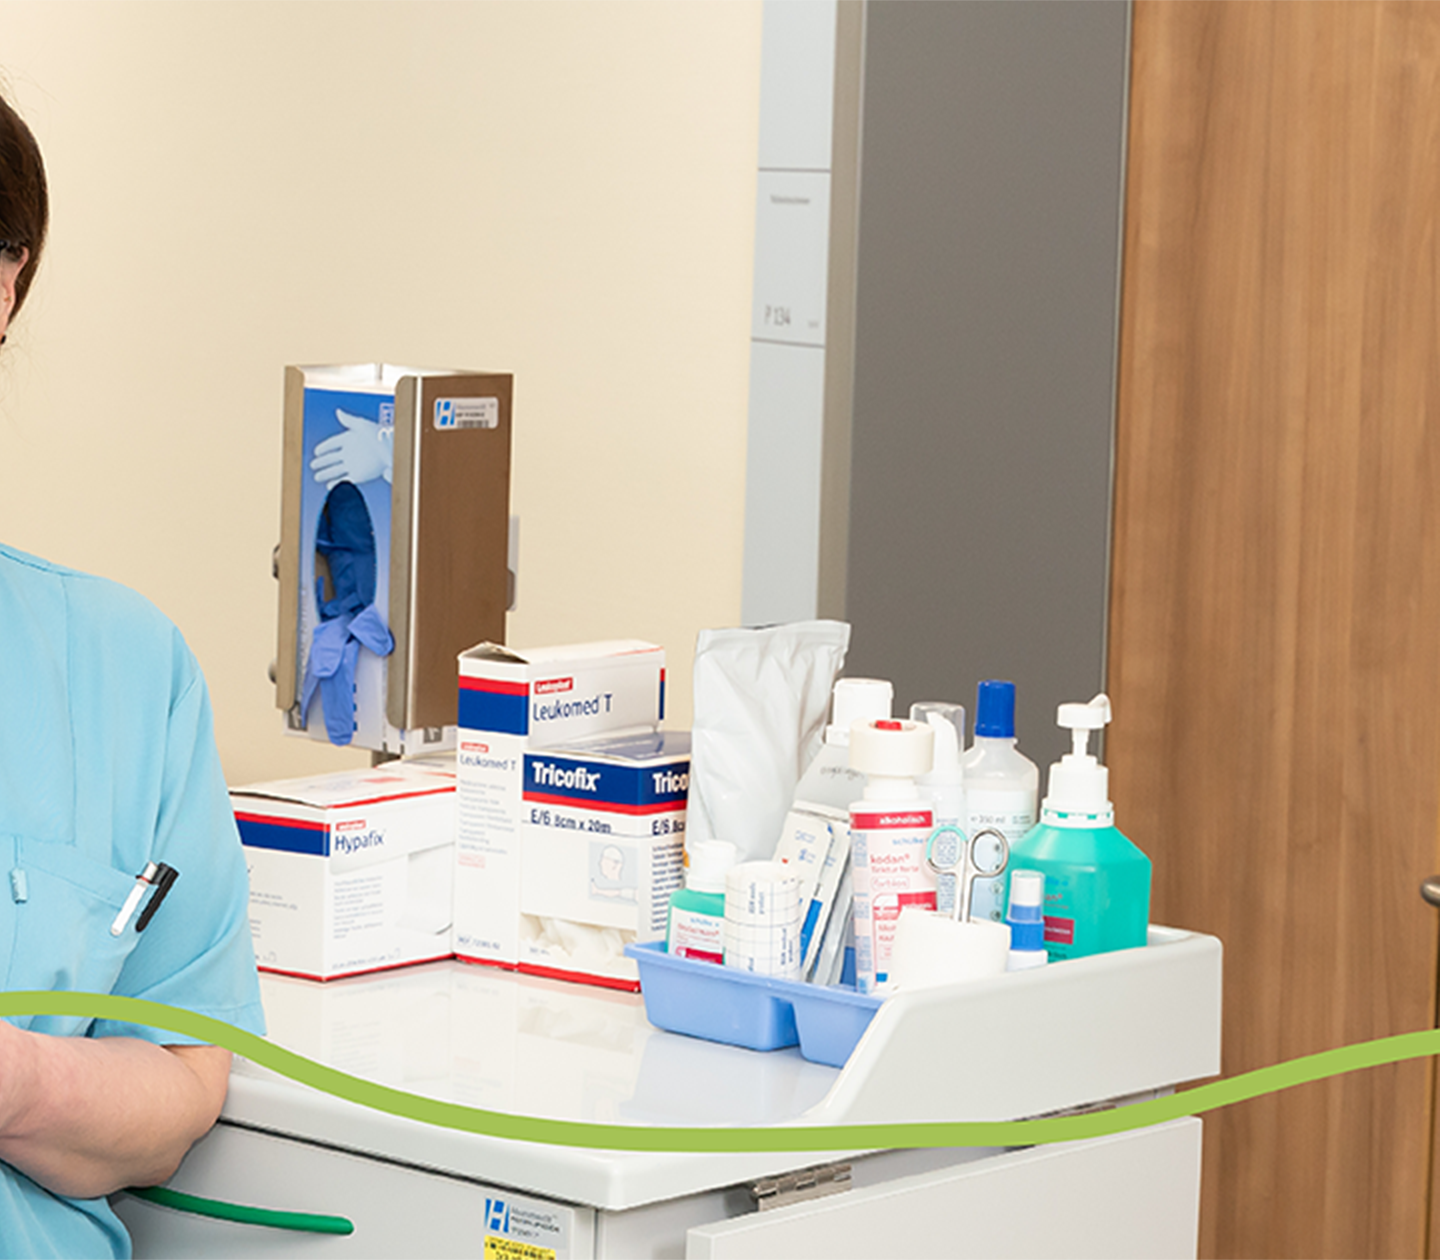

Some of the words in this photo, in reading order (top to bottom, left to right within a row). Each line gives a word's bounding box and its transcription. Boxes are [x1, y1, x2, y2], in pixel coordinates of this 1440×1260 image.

[532, 696, 600, 722] Leukomed
[603, 693, 613, 713] T
[459, 753, 508, 771] Leukomed
[531, 761, 601, 792] Tricofix
[652, 770, 690, 794] Trico
[588, 819, 612, 834] 20m
[334, 829, 385, 854] Hypafix
